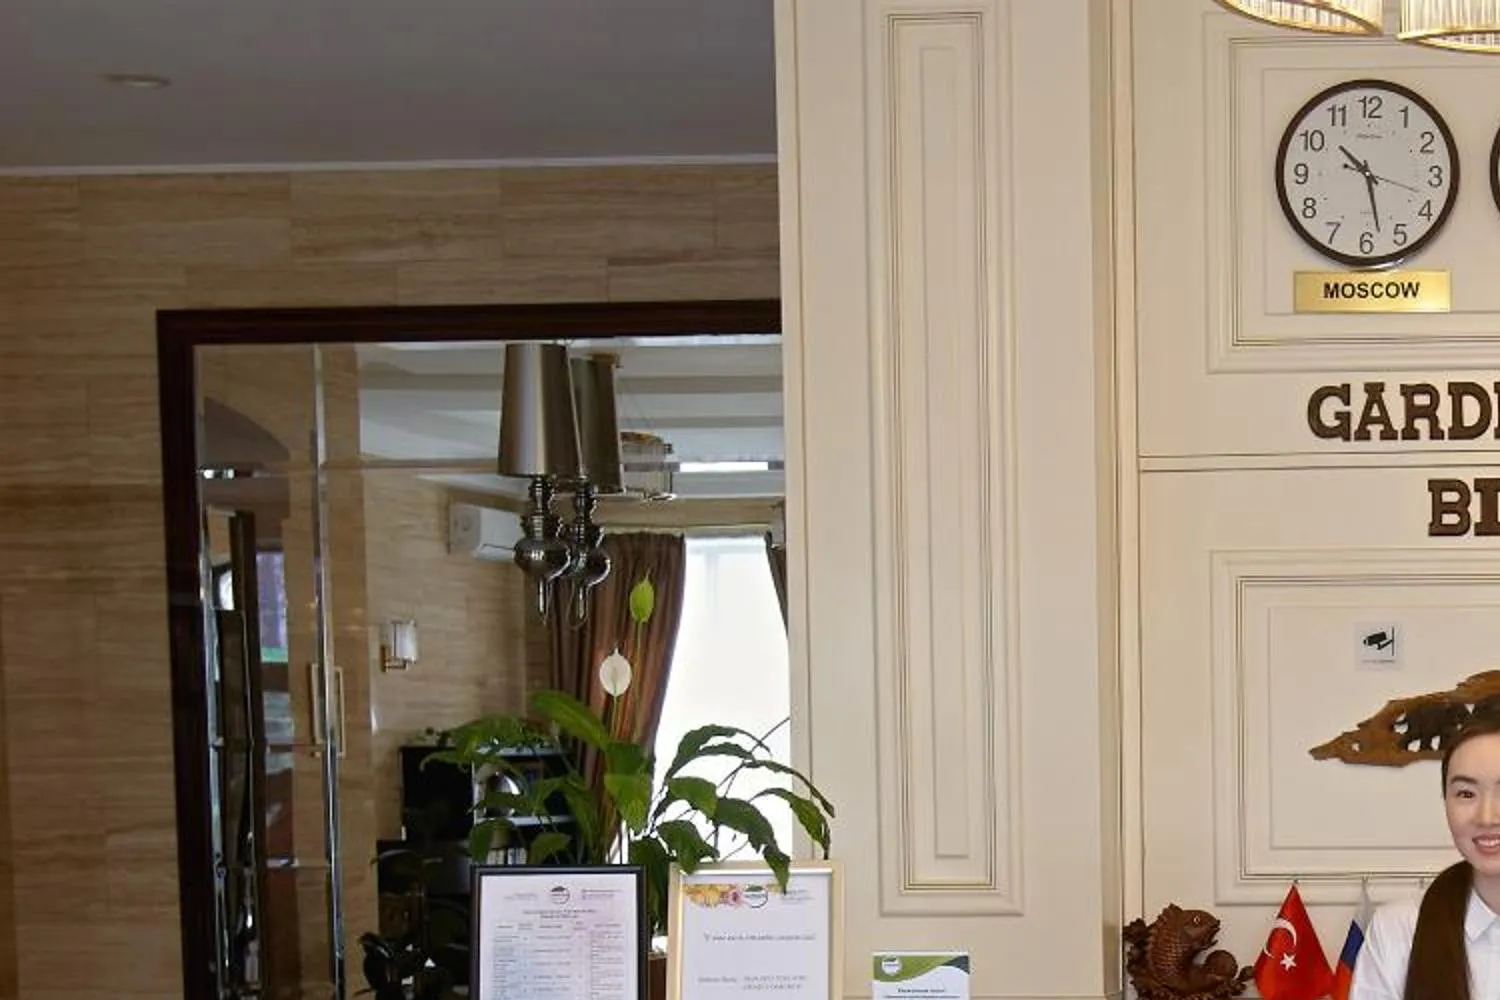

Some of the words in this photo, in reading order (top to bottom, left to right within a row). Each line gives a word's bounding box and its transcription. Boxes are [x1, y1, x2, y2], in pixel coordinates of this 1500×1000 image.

[1326, 104, 1347, 127] 11
[1358, 95, 1383, 119] 12
[1398, 105, 1409, 128] 1
[1299, 129, 1325, 152] 10
[1419, 131, 1435, 153] 2
[1293, 162, 1309, 185] 9
[1427, 164, 1443, 188] 3
[1302, 196, 1317, 219] 8
[1417, 199, 1433, 222] 4
[1325, 221, 1341, 244] 7
[1359, 231, 1375, 254] 6
[1392, 223, 1408, 246] 5
[1323, 281, 1420, 299] MOSCOW
